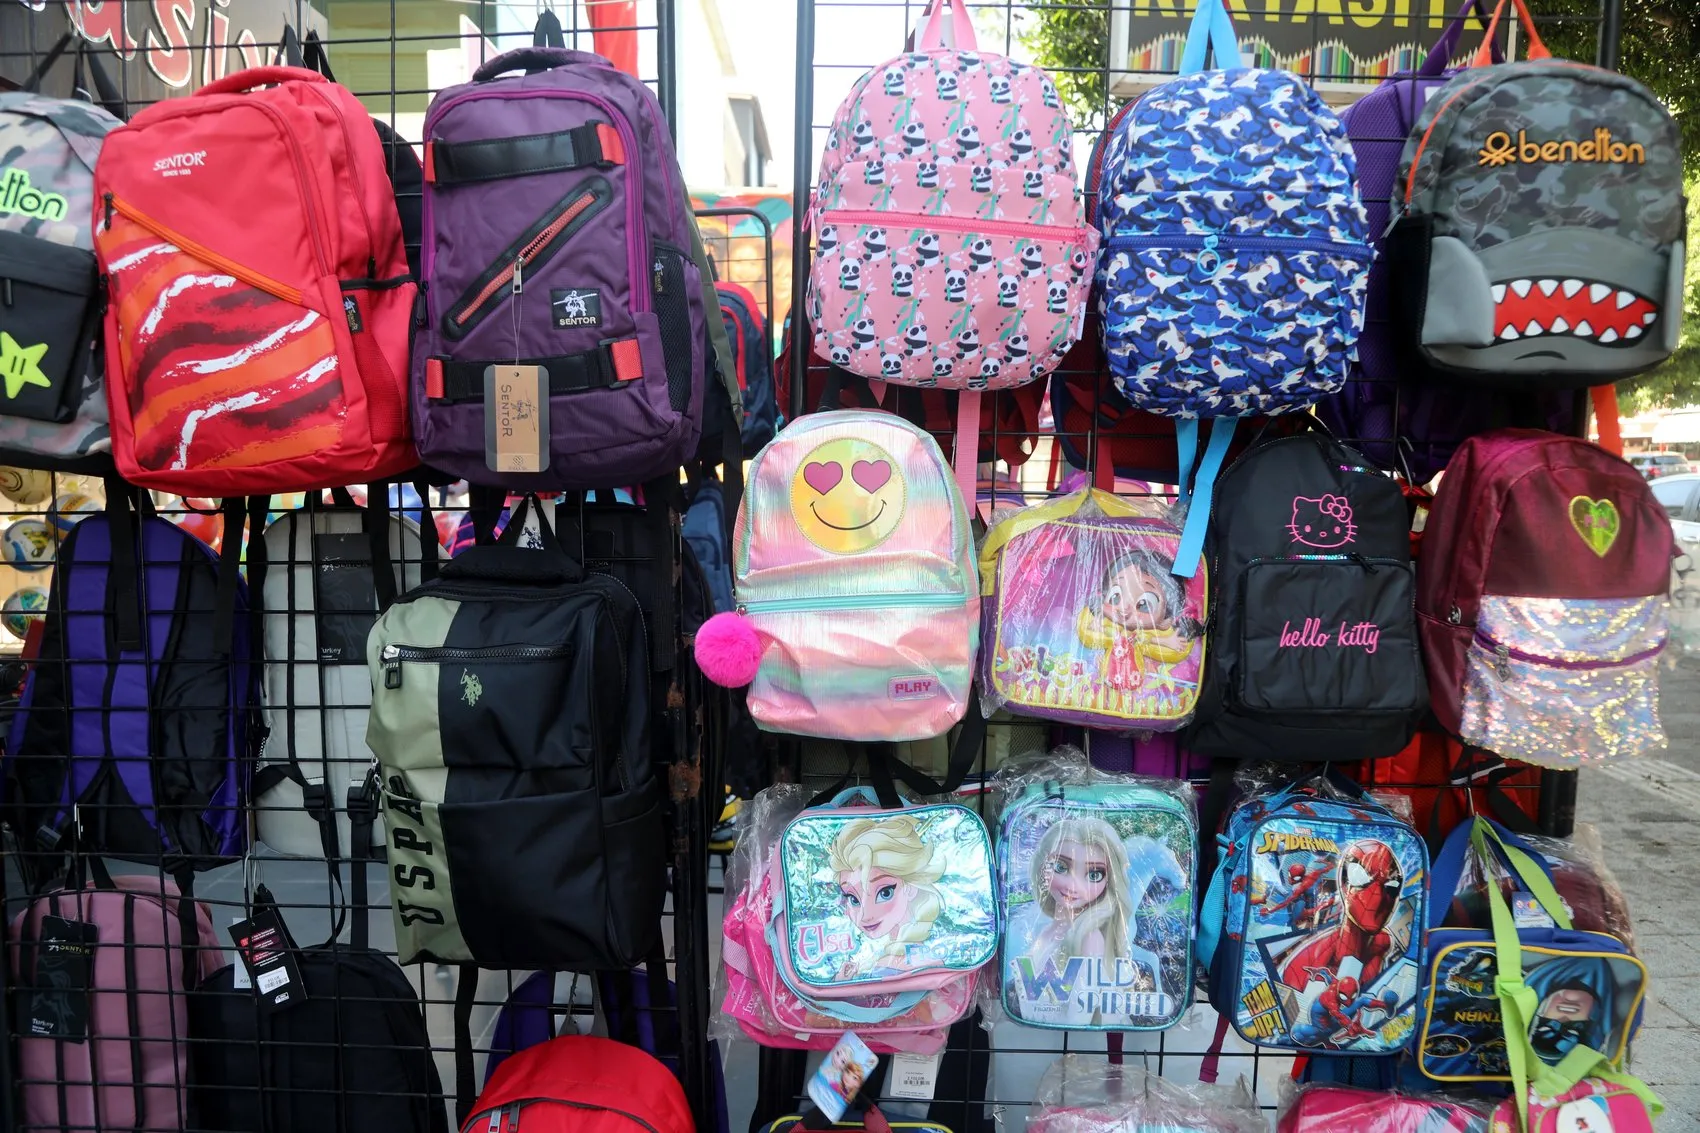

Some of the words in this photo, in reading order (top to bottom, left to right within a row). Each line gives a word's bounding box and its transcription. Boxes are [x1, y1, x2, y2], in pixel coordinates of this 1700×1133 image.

[1518, 127, 1645, 164] benetton
[0, 171, 65, 218] tton
[559, 316, 597, 326] SENTOR
[501, 384, 513, 437] SENTOR
[1280, 618, 1331, 648] hello
[1337, 621, 1380, 654] kitty
[895, 681, 932, 694] PLAY
[1256, 831, 1341, 855] SPIDER-MAN
[799, 925, 855, 964] Elsa
[1016, 957, 1137, 1001] WILD
[1242, 979, 1277, 1016] TEAM
[1252, 1009, 1286, 1039] UP!
[1454, 1010, 1501, 1023] TMAN
